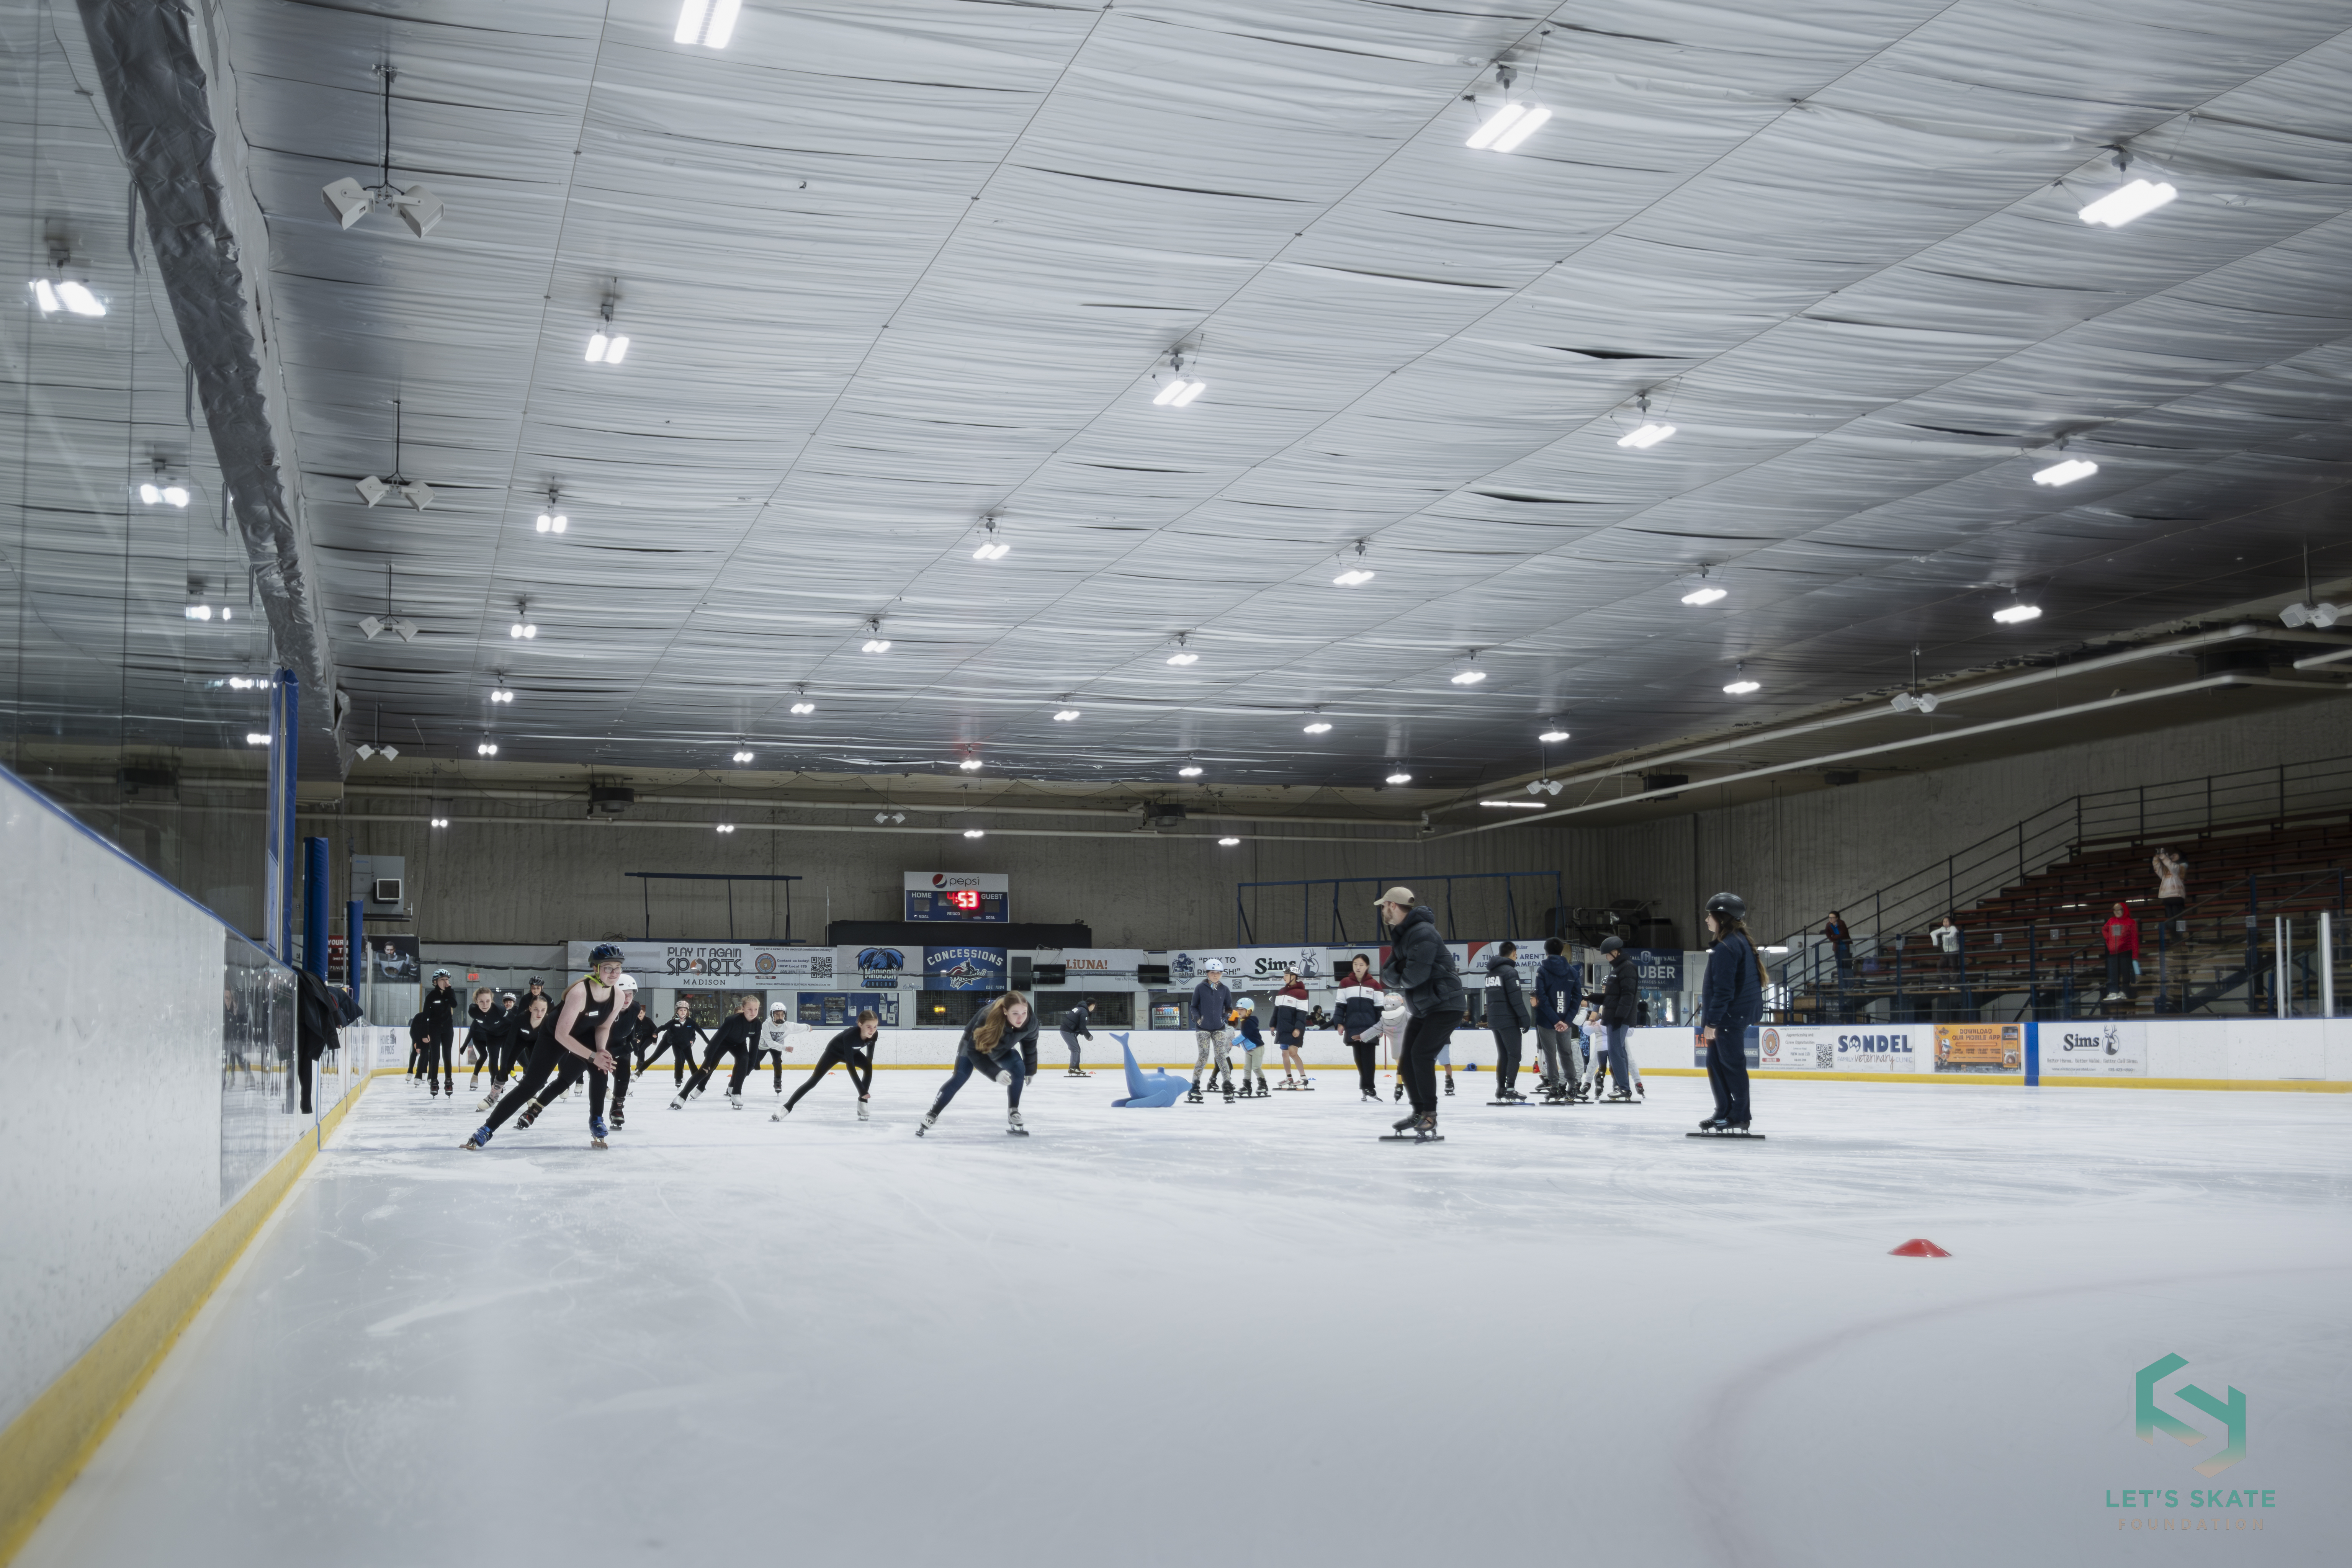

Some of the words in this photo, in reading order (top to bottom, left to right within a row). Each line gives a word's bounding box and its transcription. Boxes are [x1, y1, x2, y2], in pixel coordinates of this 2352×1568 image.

[949, 876, 980, 887] pepsi
[947, 892, 977, 907] 4:53
[667, 947, 693, 957] PLAY
[697, 947, 707, 957] IT
[709, 948, 742, 958] AGAIN
[927, 949, 1003, 966] CONCESSIONS
[666, 957, 742, 977] SPORTS
[1066, 958, 1108, 970] LiUNA!
[864, 968, 897, 979] MADISON
[1638, 966, 1675, 979] UBER
[1485, 976, 1501, 987] USA
[2063, 1033, 2099, 1051] Sims
[1855, 1052, 1895, 1071] veterinary
